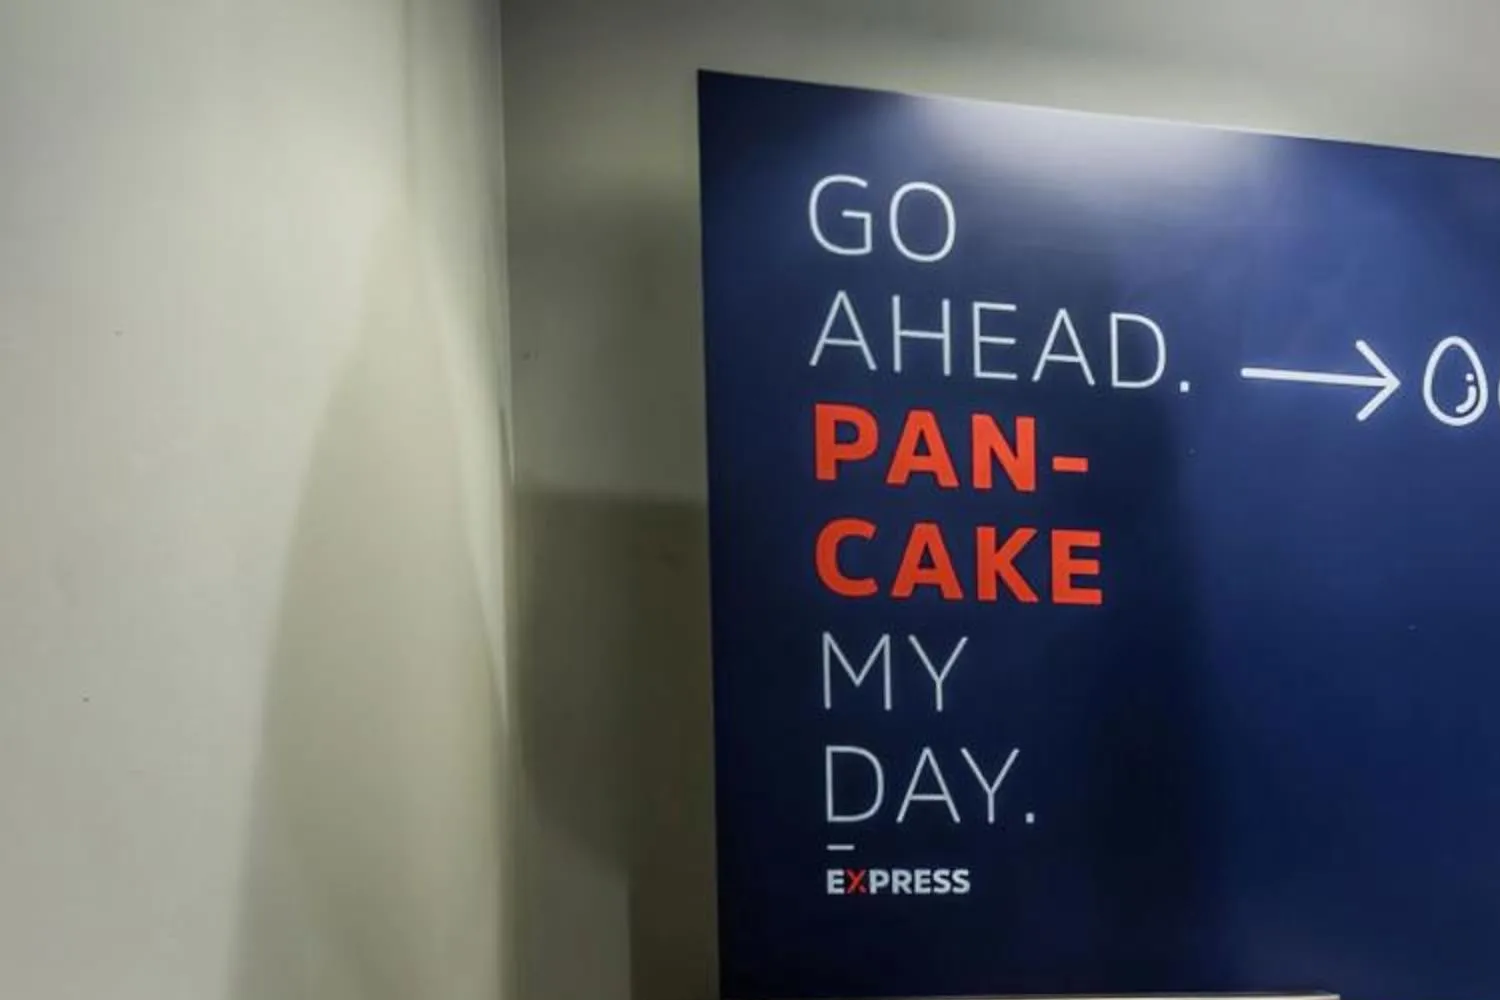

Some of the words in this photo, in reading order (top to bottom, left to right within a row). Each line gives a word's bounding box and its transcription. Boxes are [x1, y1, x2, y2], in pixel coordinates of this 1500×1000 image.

[808, 174, 957, 263] GO
[808, 290, 1190, 393] AHEAD.
[814, 403, 1089, 492] PAN-
[814, 517, 1103, 605] CAKE
[822, 631, 968, 712] MY
[825, 744, 1035, 824] DAY.
[826, 868, 971, 895] EXPRESS
